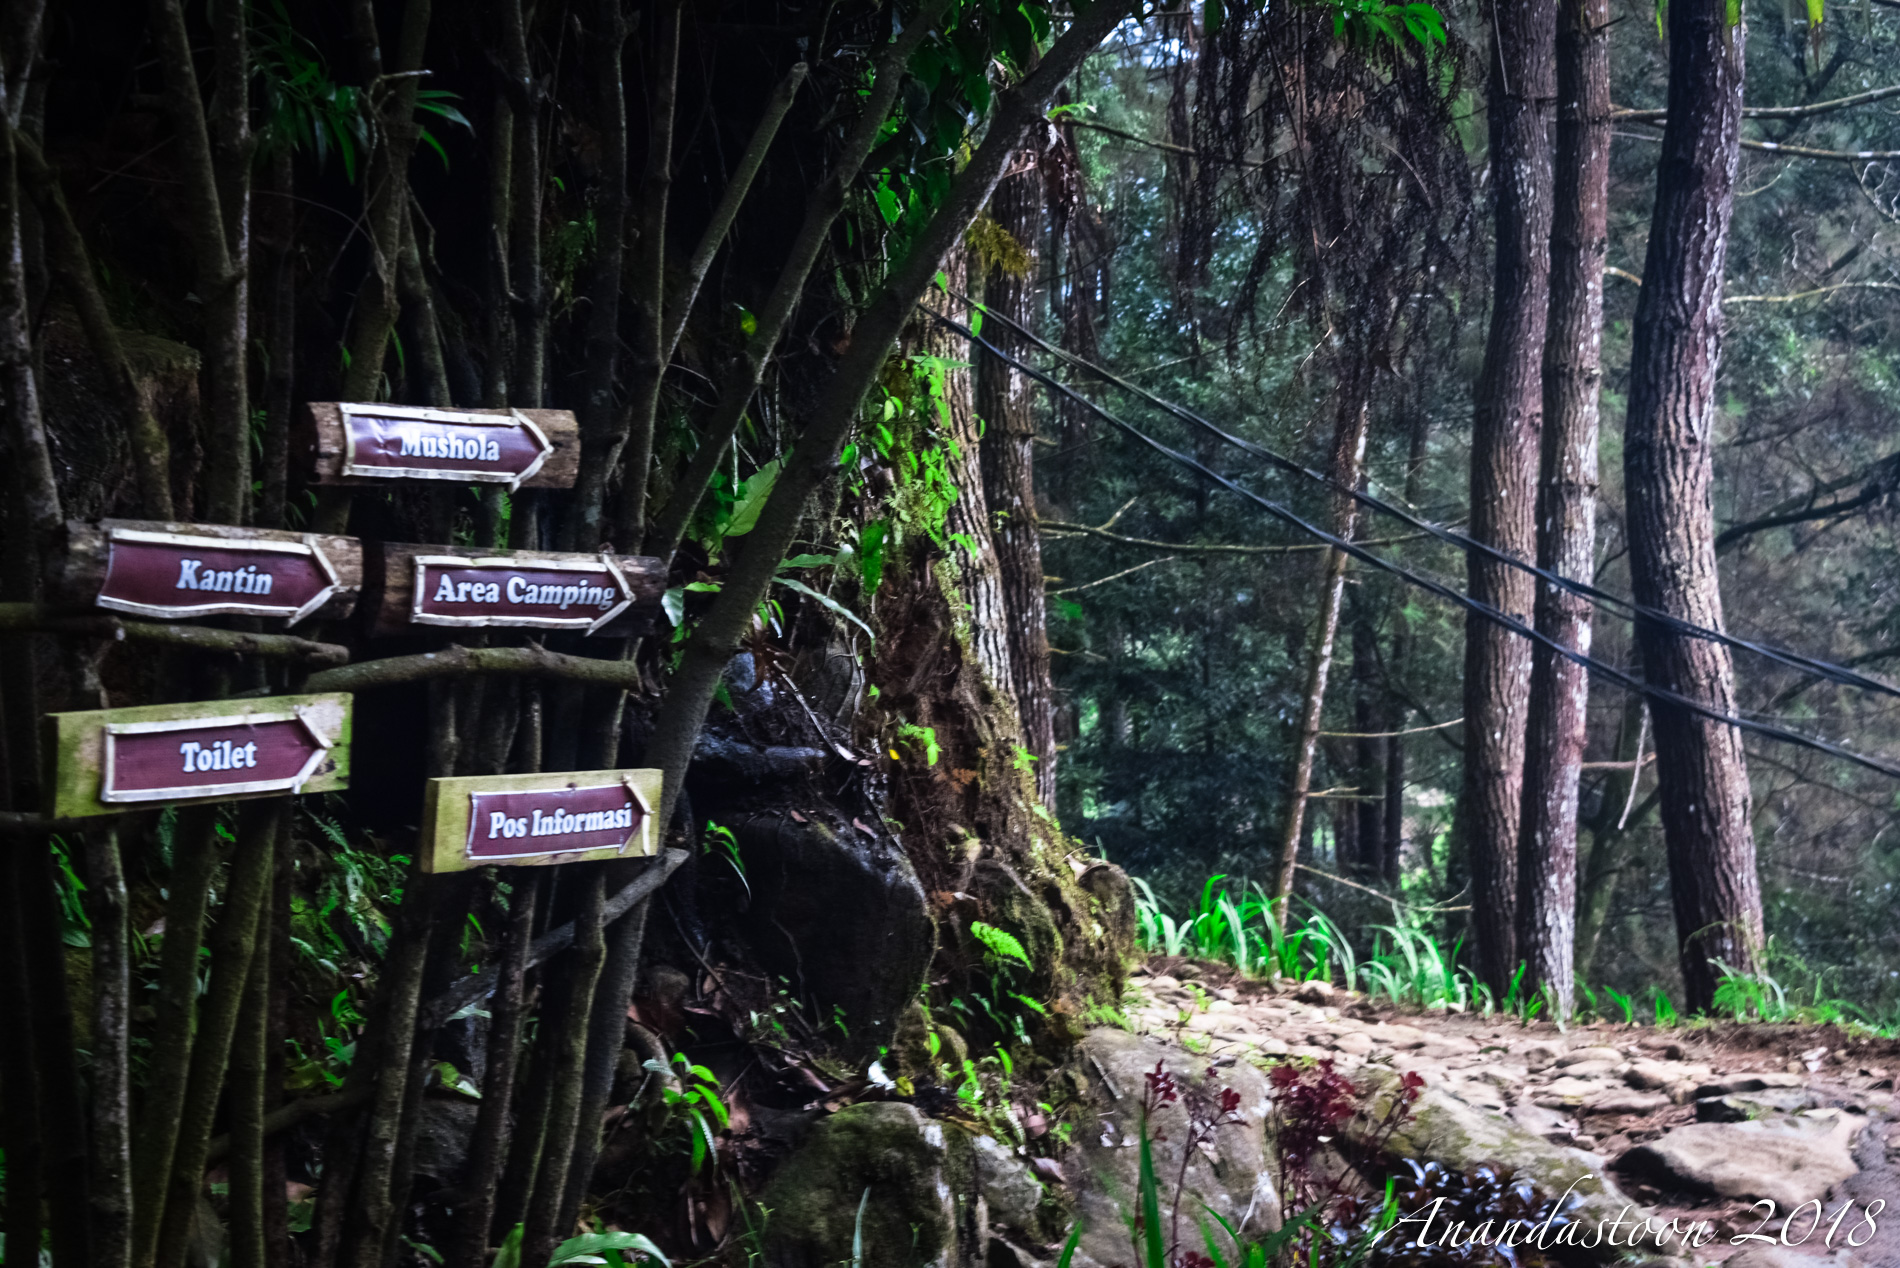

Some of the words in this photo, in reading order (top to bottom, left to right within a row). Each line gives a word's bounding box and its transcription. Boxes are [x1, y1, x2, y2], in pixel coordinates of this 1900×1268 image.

[400, 429, 501, 462] Mushola
[175, 558, 273, 595] Kantin
[433, 573, 500, 604] Area
[506, 575, 616, 611] Camping
[179, 740, 258, 773] Toilet
[488, 811, 528, 840] Pos
[530, 801, 633, 837] Informasi
